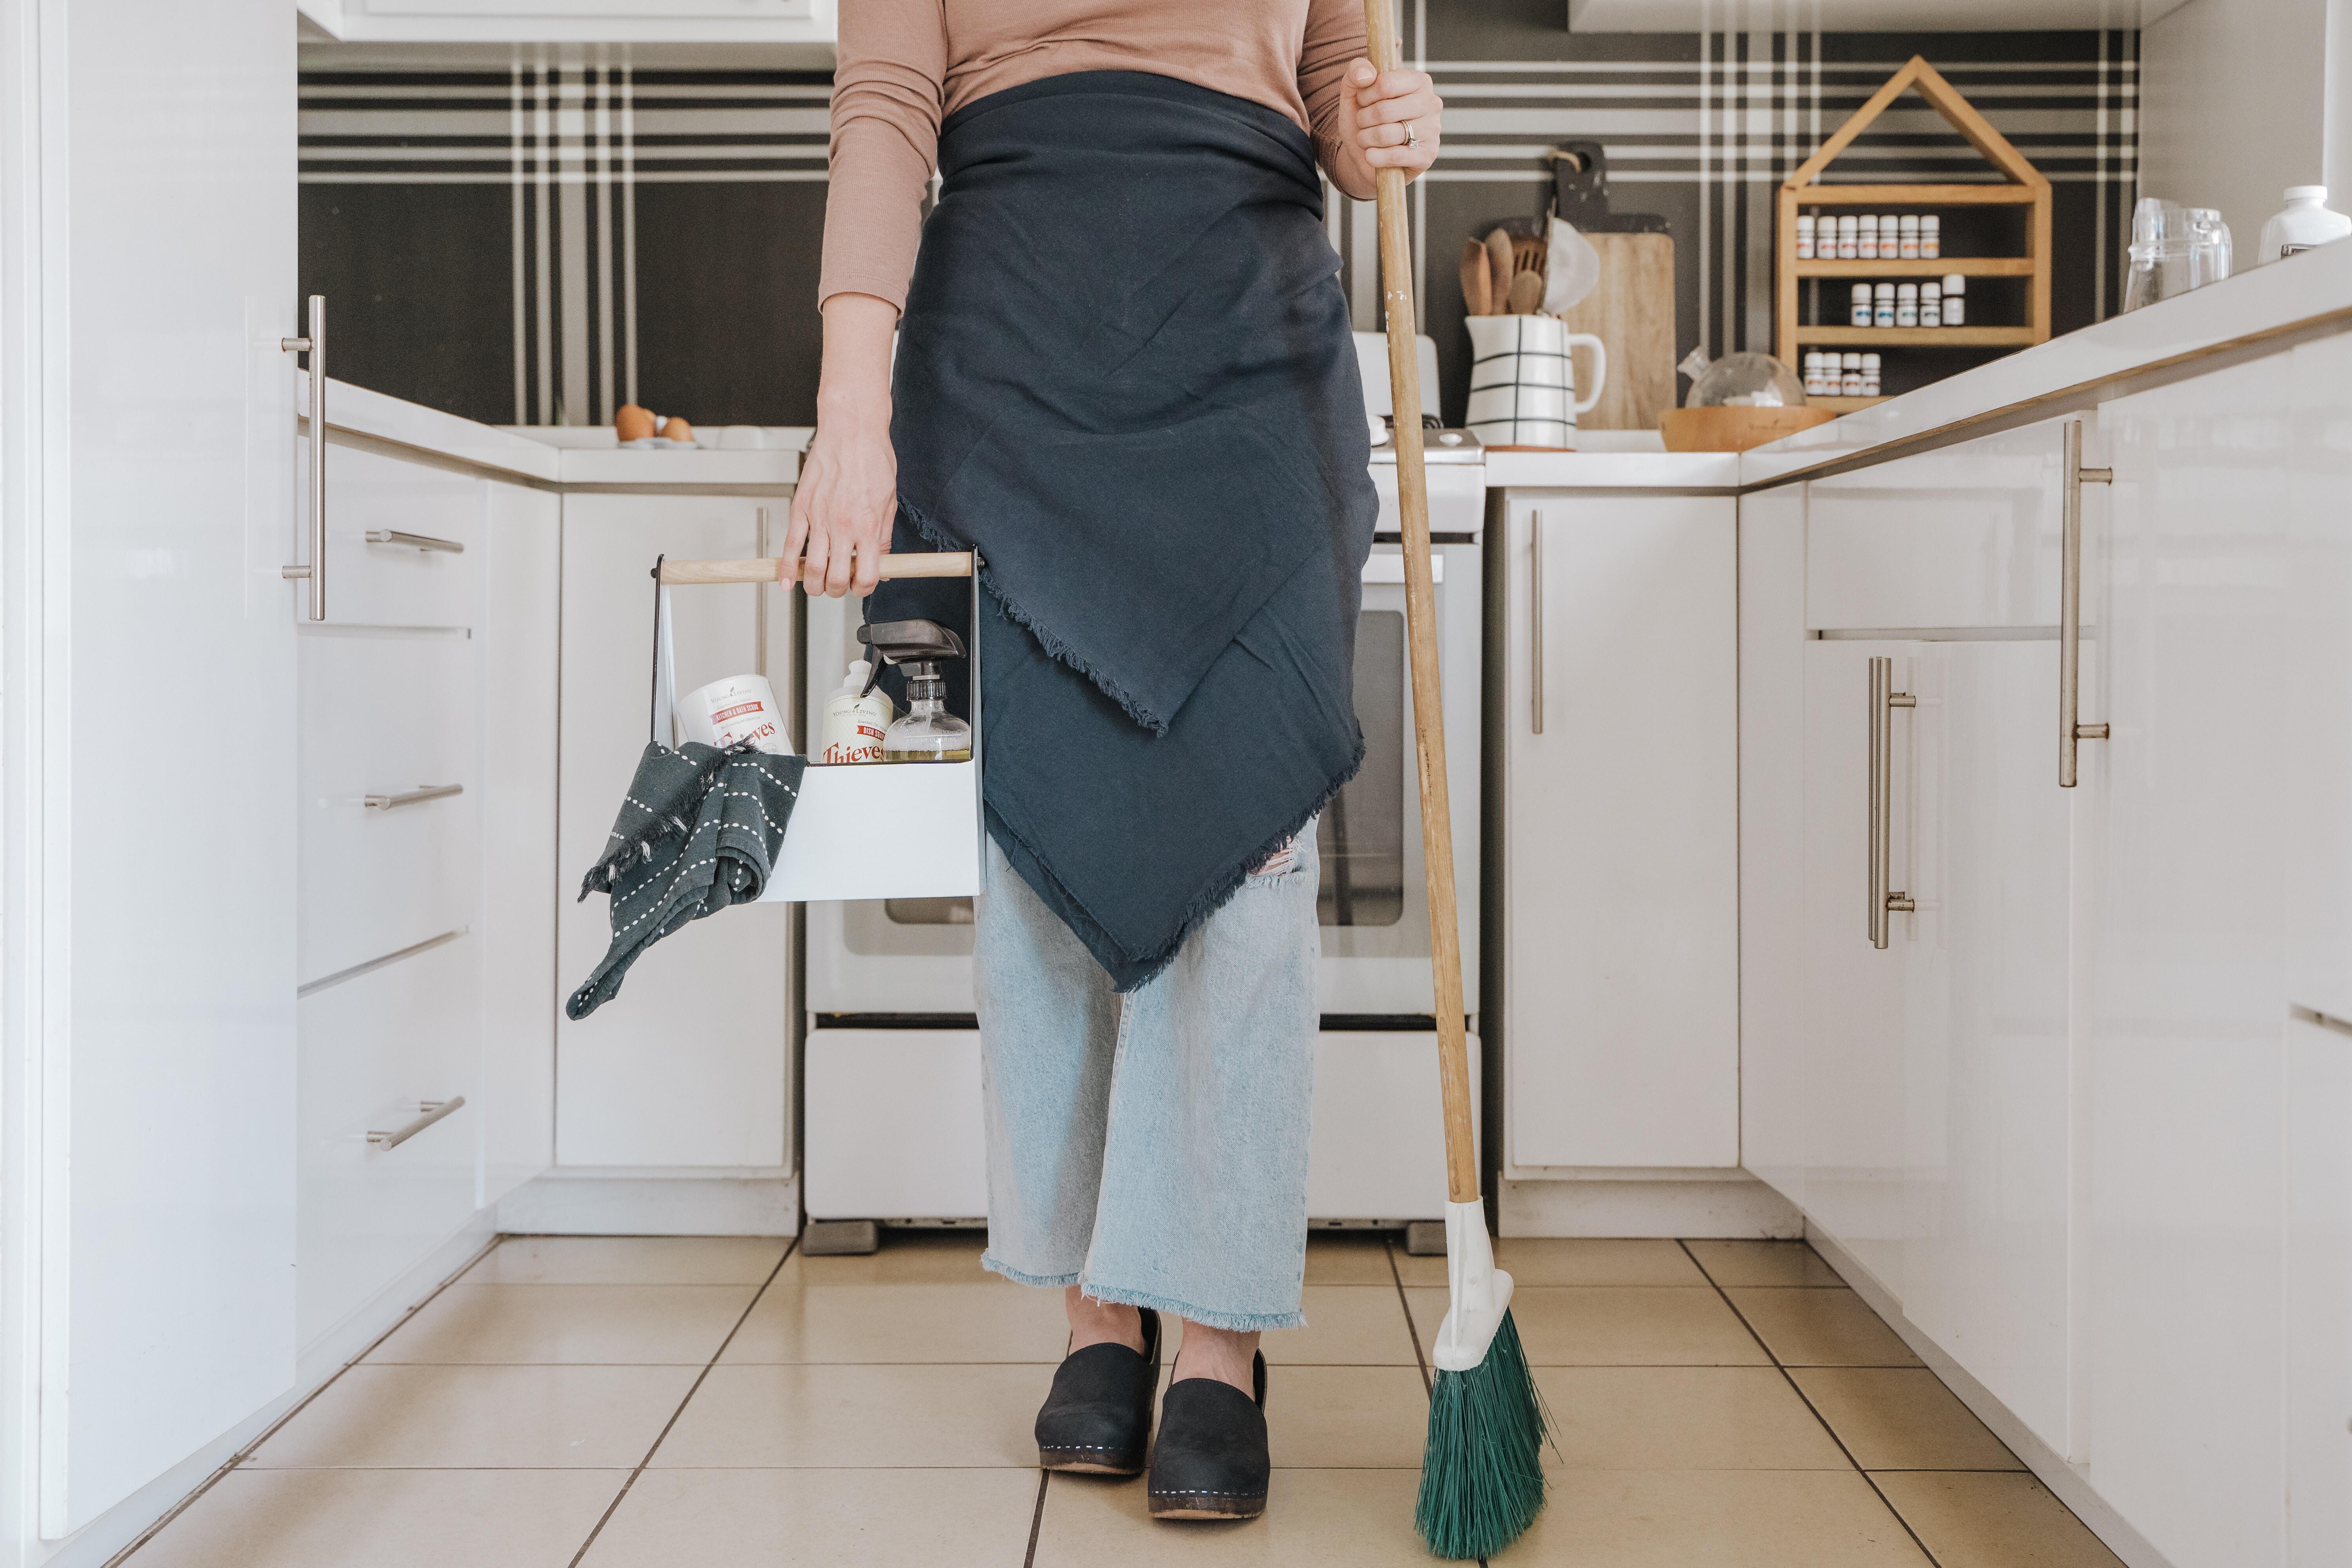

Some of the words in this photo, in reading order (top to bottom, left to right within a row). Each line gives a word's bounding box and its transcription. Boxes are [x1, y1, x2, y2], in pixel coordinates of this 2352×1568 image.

[710, 695, 730, 703] YOUNG
[716, 710, 732, 721] KITCHEN
[737, 706, 747, 714] BATH
[713, 722, 775, 748] Tves
[863, 727, 874, 736] DISH
[875, 730, 885, 740] SOAP
